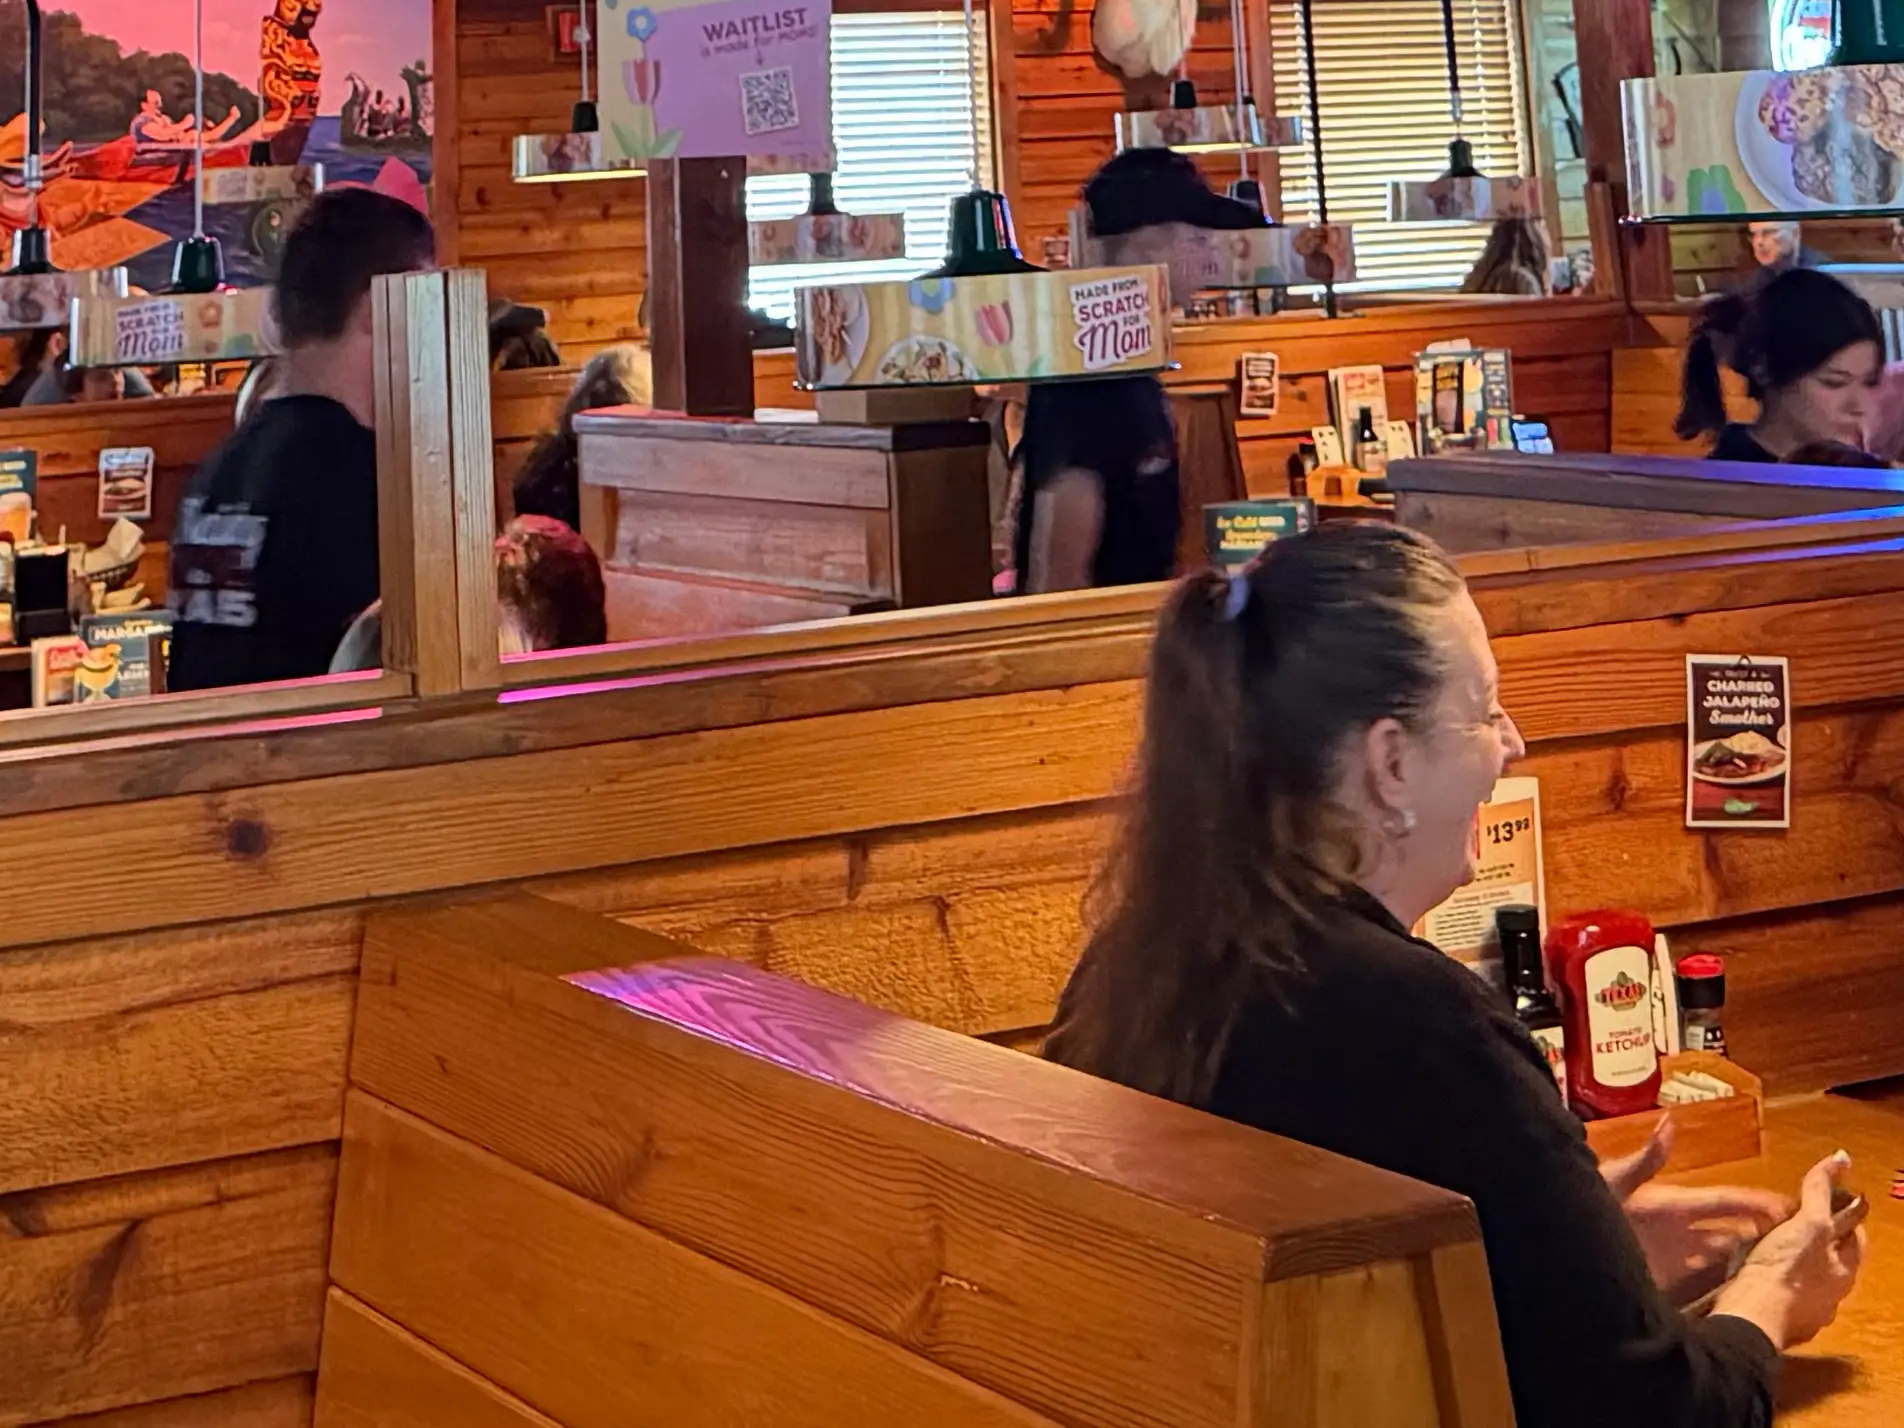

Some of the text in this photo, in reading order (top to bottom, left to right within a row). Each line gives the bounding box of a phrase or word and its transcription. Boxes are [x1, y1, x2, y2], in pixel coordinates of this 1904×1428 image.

[702, 8, 807, 42] WAITLIST
[1075, 285, 1109, 301] MADE
[117, 330, 183, 357] Mom
[1078, 320, 1152, 362] Mom
